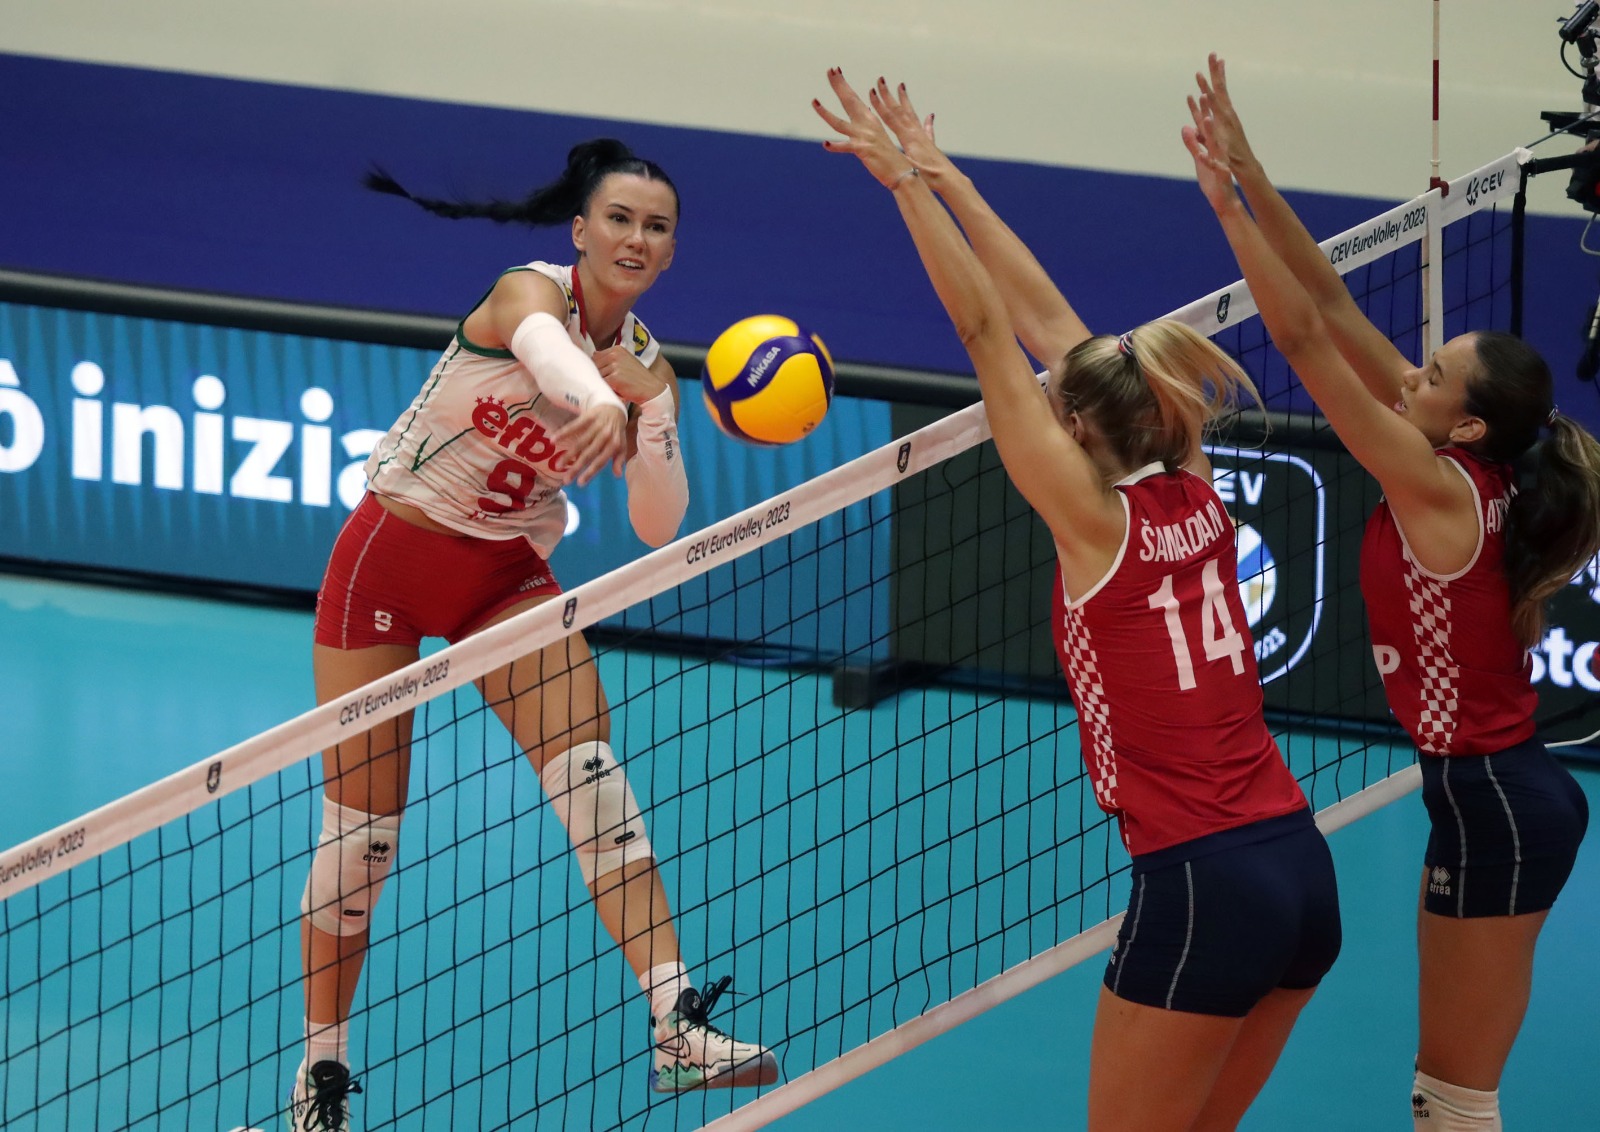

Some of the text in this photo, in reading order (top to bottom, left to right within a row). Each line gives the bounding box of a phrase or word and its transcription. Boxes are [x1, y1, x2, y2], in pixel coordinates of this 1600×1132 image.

[1480, 170, 1505, 195] CEV
[1330, 206, 1426, 265] CEV EuroVolley 2023
[1213, 467, 1266, 506] EV
[686, 501, 791, 565] CEV EuroVolley 2023
[1139, 499, 1225, 562] ŠAMADAN
[374, 610, 392, 632] 9
[1147, 558, 1246, 691] 14
[339, 659, 450, 726] CEV EuroVolley 2023
[57, 827, 86, 858] 2023
[1430, 882, 1451, 896] errea
